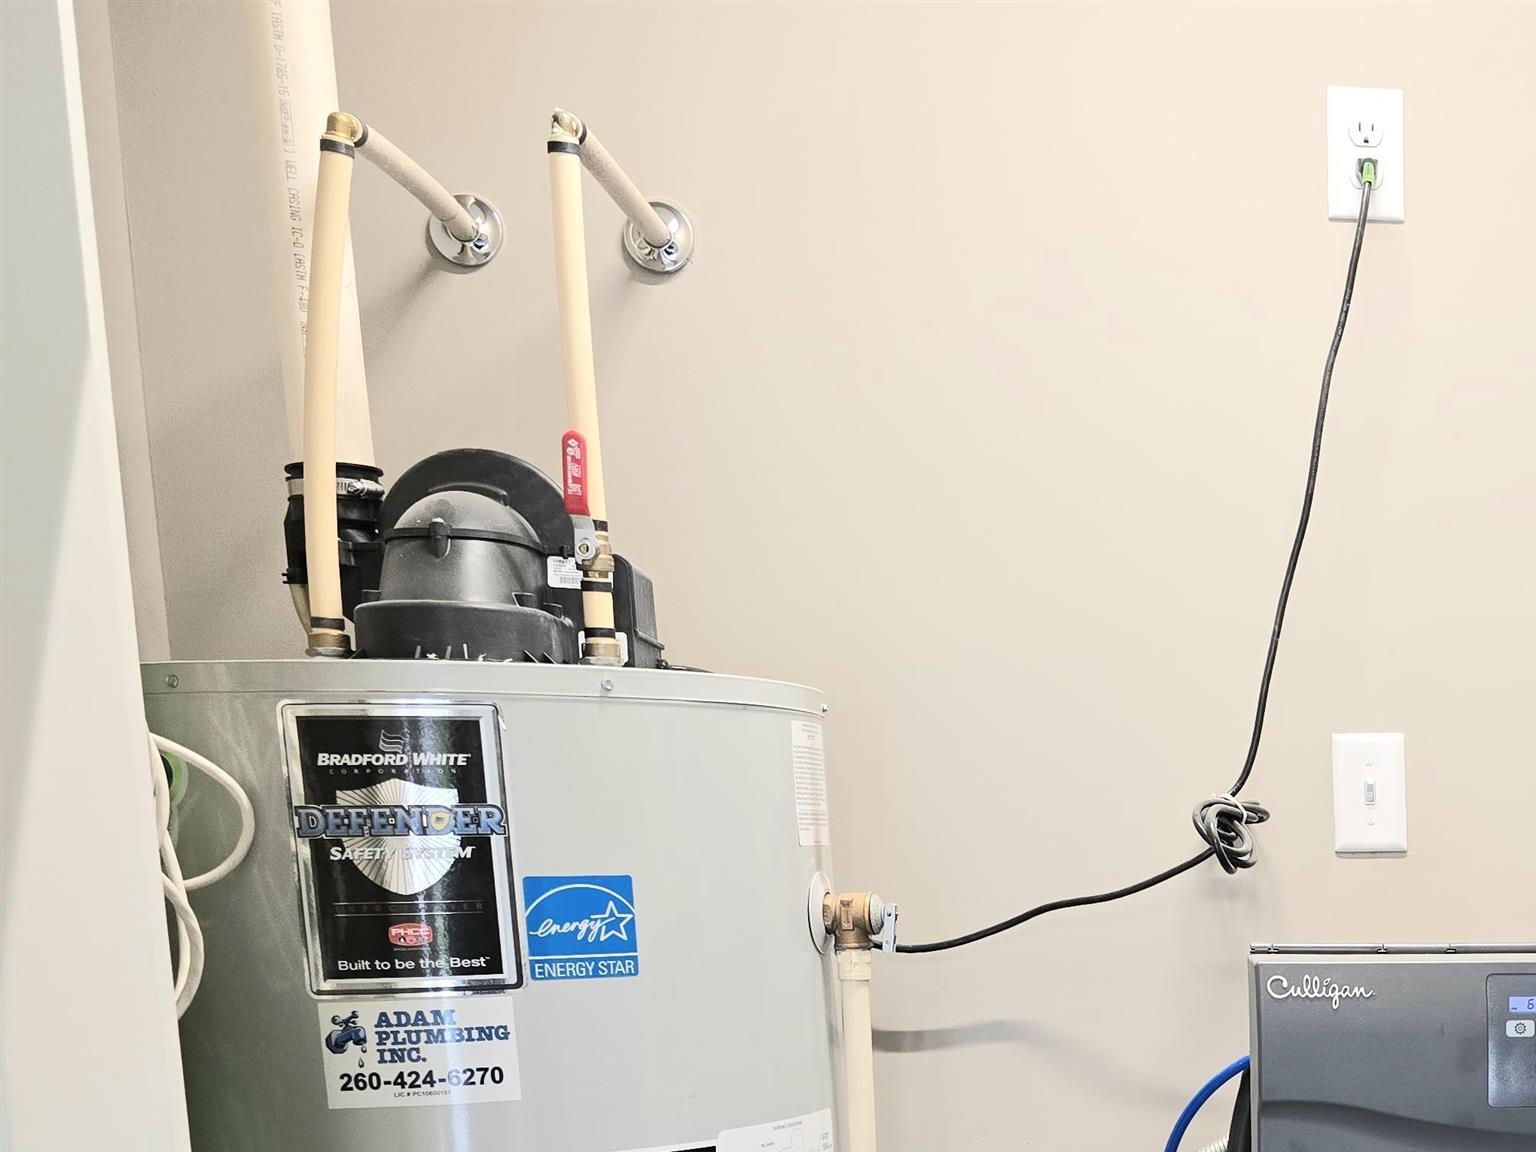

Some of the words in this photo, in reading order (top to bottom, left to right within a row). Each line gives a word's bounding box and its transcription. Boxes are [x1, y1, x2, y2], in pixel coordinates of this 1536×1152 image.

[317, 753, 408, 766] BRADFORD
[413, 753, 468, 766] WHITE
[297, 806, 507, 837] DEFENDER
[329, 847, 395, 861] SAFETY
[402, 846, 473, 860] SYSTEM
[528, 916, 615, 942] energy
[338, 958, 371, 971] Built
[374, 958, 392, 970] to
[396, 957, 415, 970] be
[420, 956, 444, 969] the
[450, 956, 487, 969] Best
[535, 962, 595, 979] ENERGY
[598, 960, 635, 976] STAR
[1267, 974, 1373, 1010] Culligan
[374, 1009, 456, 1028] ADAM
[375, 1025, 511, 1046] PLUMBING
[377, 1047, 427, 1064] INC.
[339, 1066, 504, 1092] 260-424-6270
